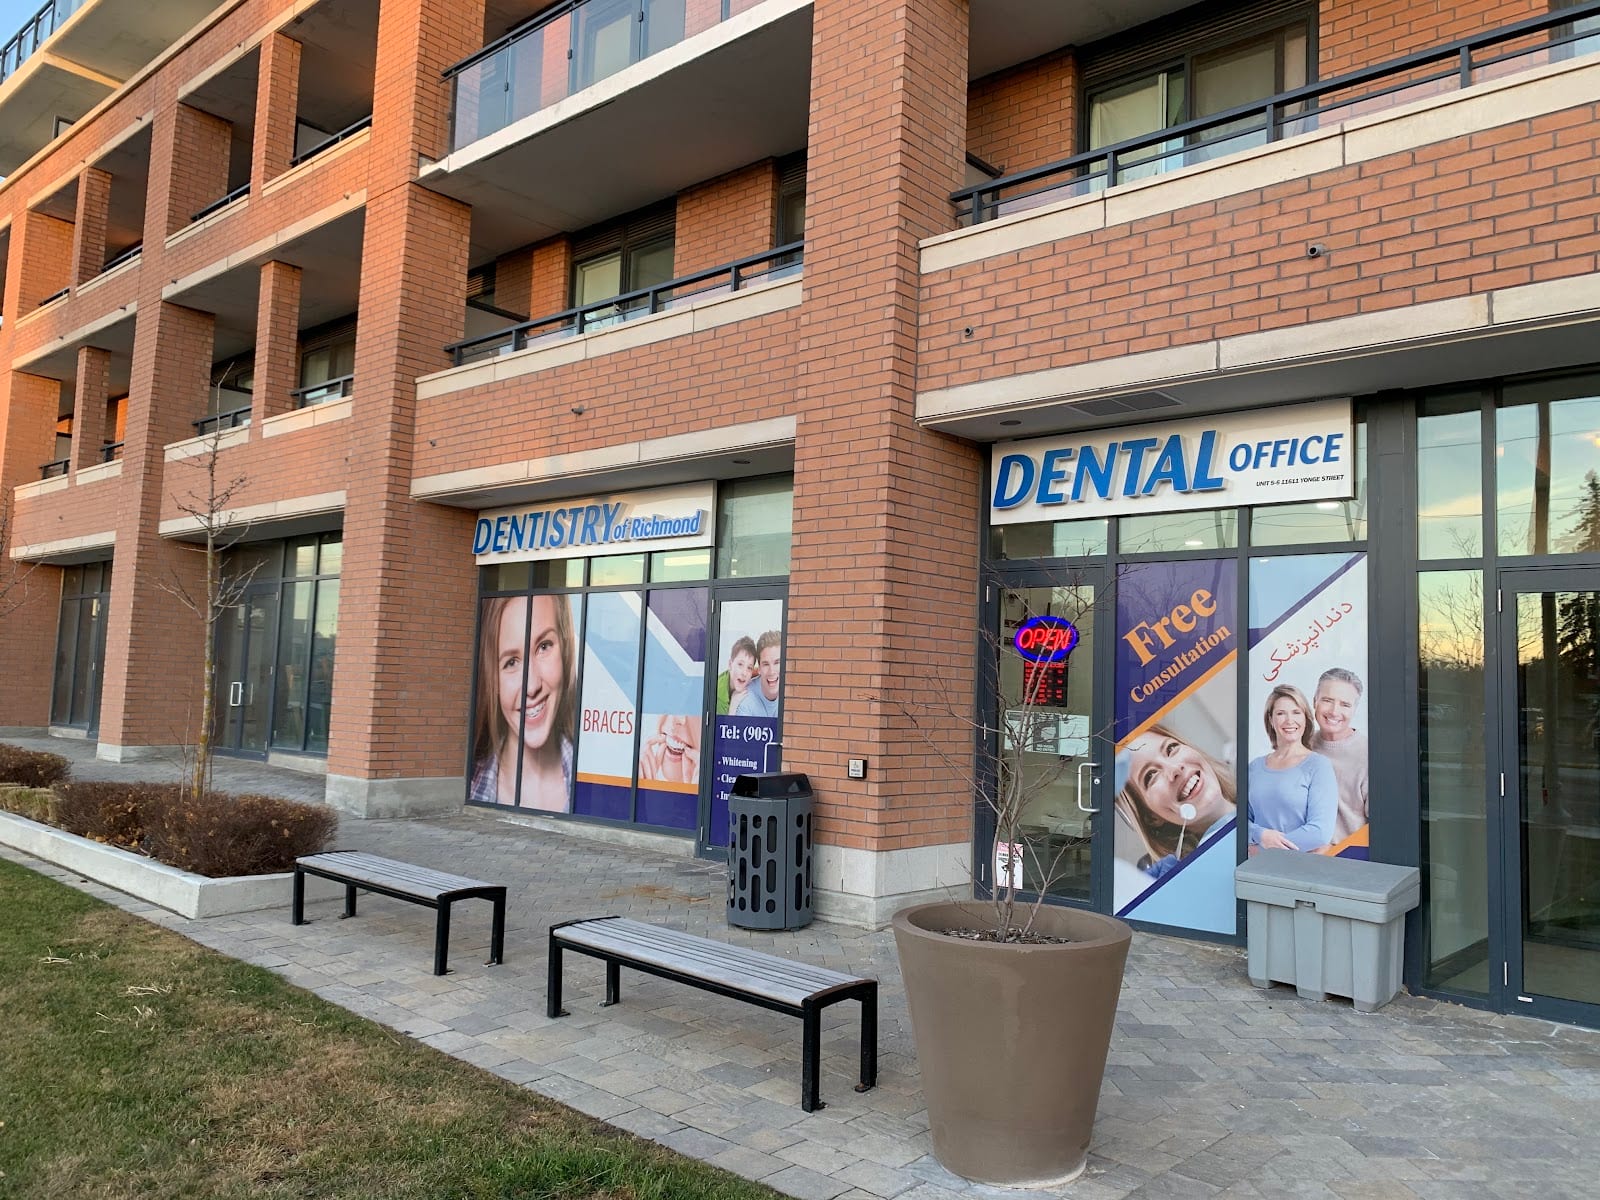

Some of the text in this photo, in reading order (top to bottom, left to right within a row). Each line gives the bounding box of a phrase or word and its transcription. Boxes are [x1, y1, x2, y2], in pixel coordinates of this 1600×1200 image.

[992, 429, 1344, 509] DENTAL OFFICE
[472, 502, 701, 554] DENTISTRY of Richmond
[1019, 628, 1071, 650] OPEN
[1122, 588, 1217, 667] Free
[1263, 602, 1353, 682] دندانپزشکی
[1130, 625, 1232, 703] Consultation
[583, 709, 633, 735] BRACES
[720, 725, 774, 743] Tel: (905)
[721, 774, 736, 783] Clea
[722, 756, 757, 770] Whitening
